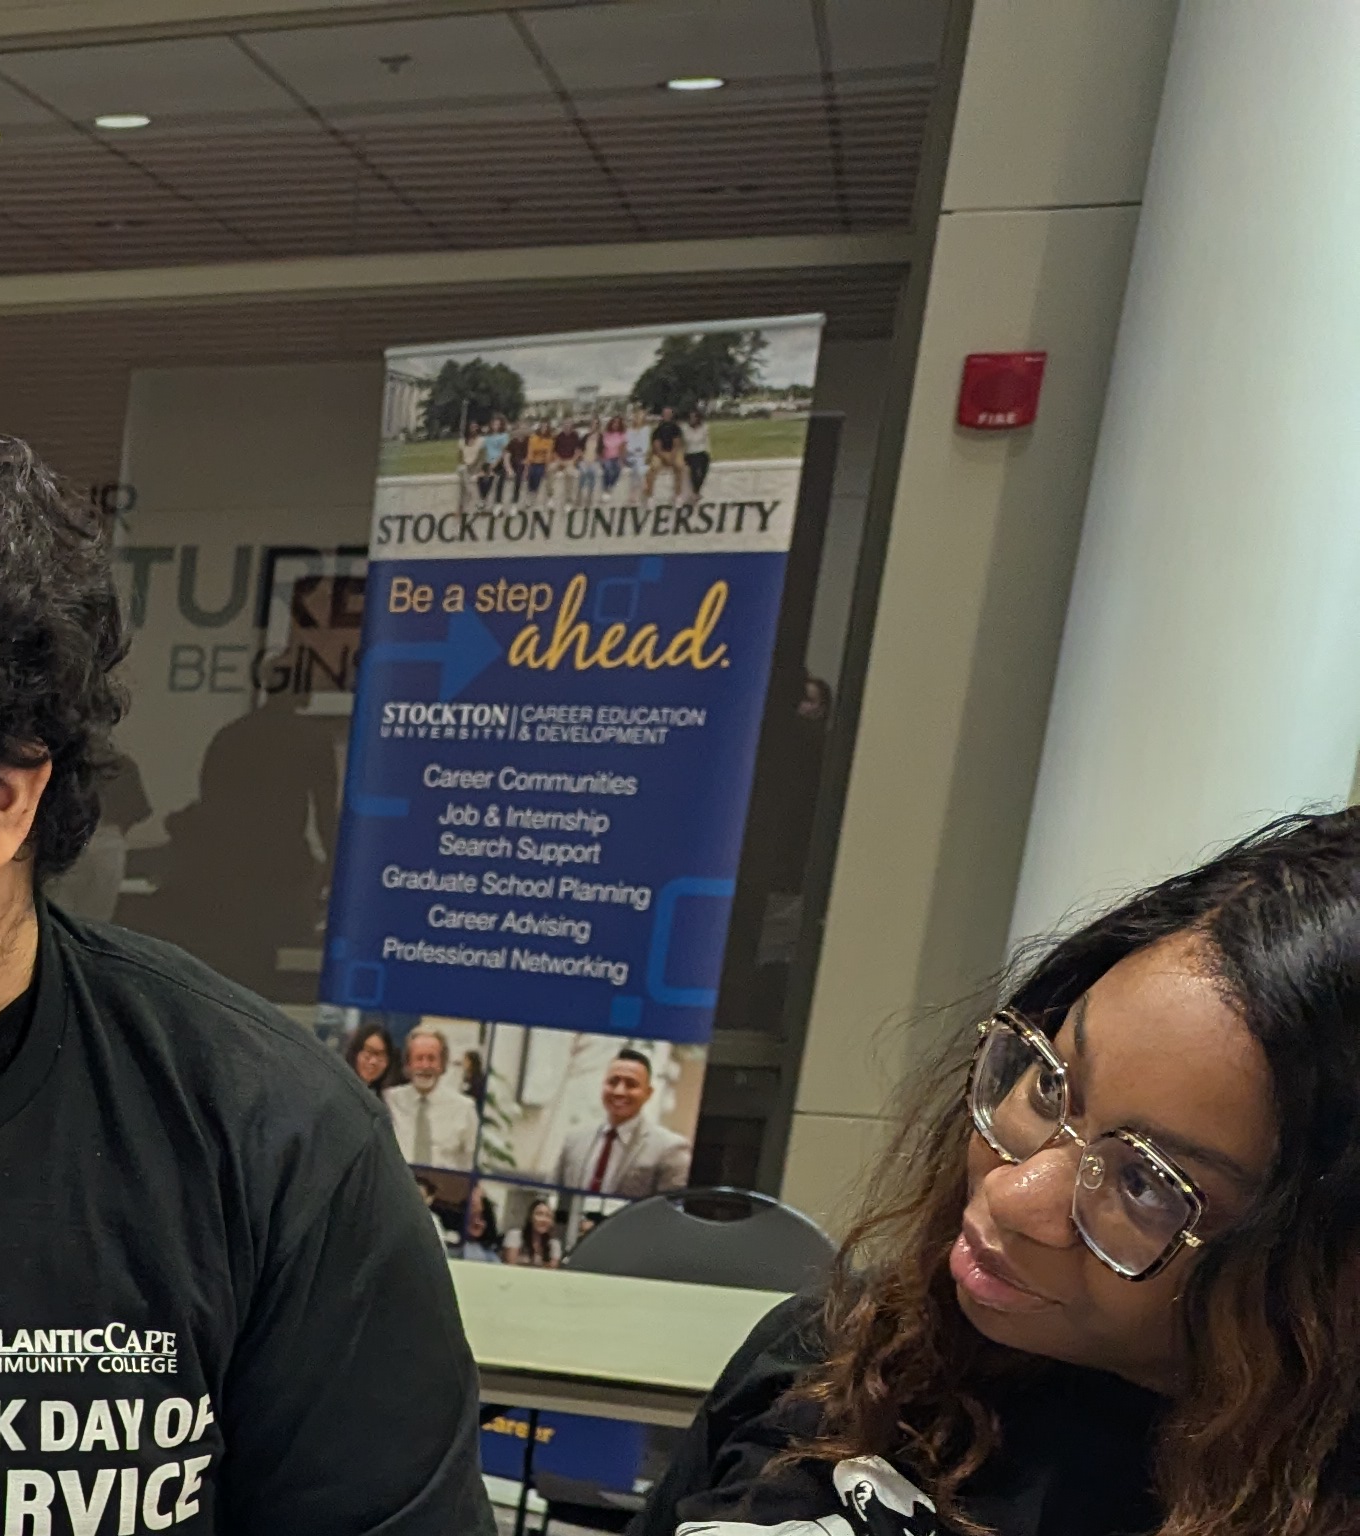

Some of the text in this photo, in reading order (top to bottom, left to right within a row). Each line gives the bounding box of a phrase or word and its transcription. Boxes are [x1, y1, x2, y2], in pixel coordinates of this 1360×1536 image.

[977, 411, 1017, 425] FIRE
[376, 500, 782, 546] STOCKTON UNIVERSITY
[114, 544, 369, 629] TURE
[389, 577, 554, 621] Be a step
[507, 573, 732, 671] ahead.
[168, 644, 362, 694] BEGIN
[380, 724, 509, 740] UNIVERSITY
[382, 703, 510, 727] STOCKTON
[521, 705, 707, 727] CAREER EDUCATION
[518, 725, 669, 745] & DEVELOPMENT
[423, 763, 639, 797] Career Communities
[438, 803, 611, 837] Job & Internship
[438, 832, 601, 866] Search Support
[382, 865, 652, 912] Graduate School Planning
[428, 904, 592, 945] Career Advising
[382, 939, 629, 986] Professional Networking
[96, 1355, 178, 1374] COLLEGE
[39, 1398, 147, 1453] DAY
